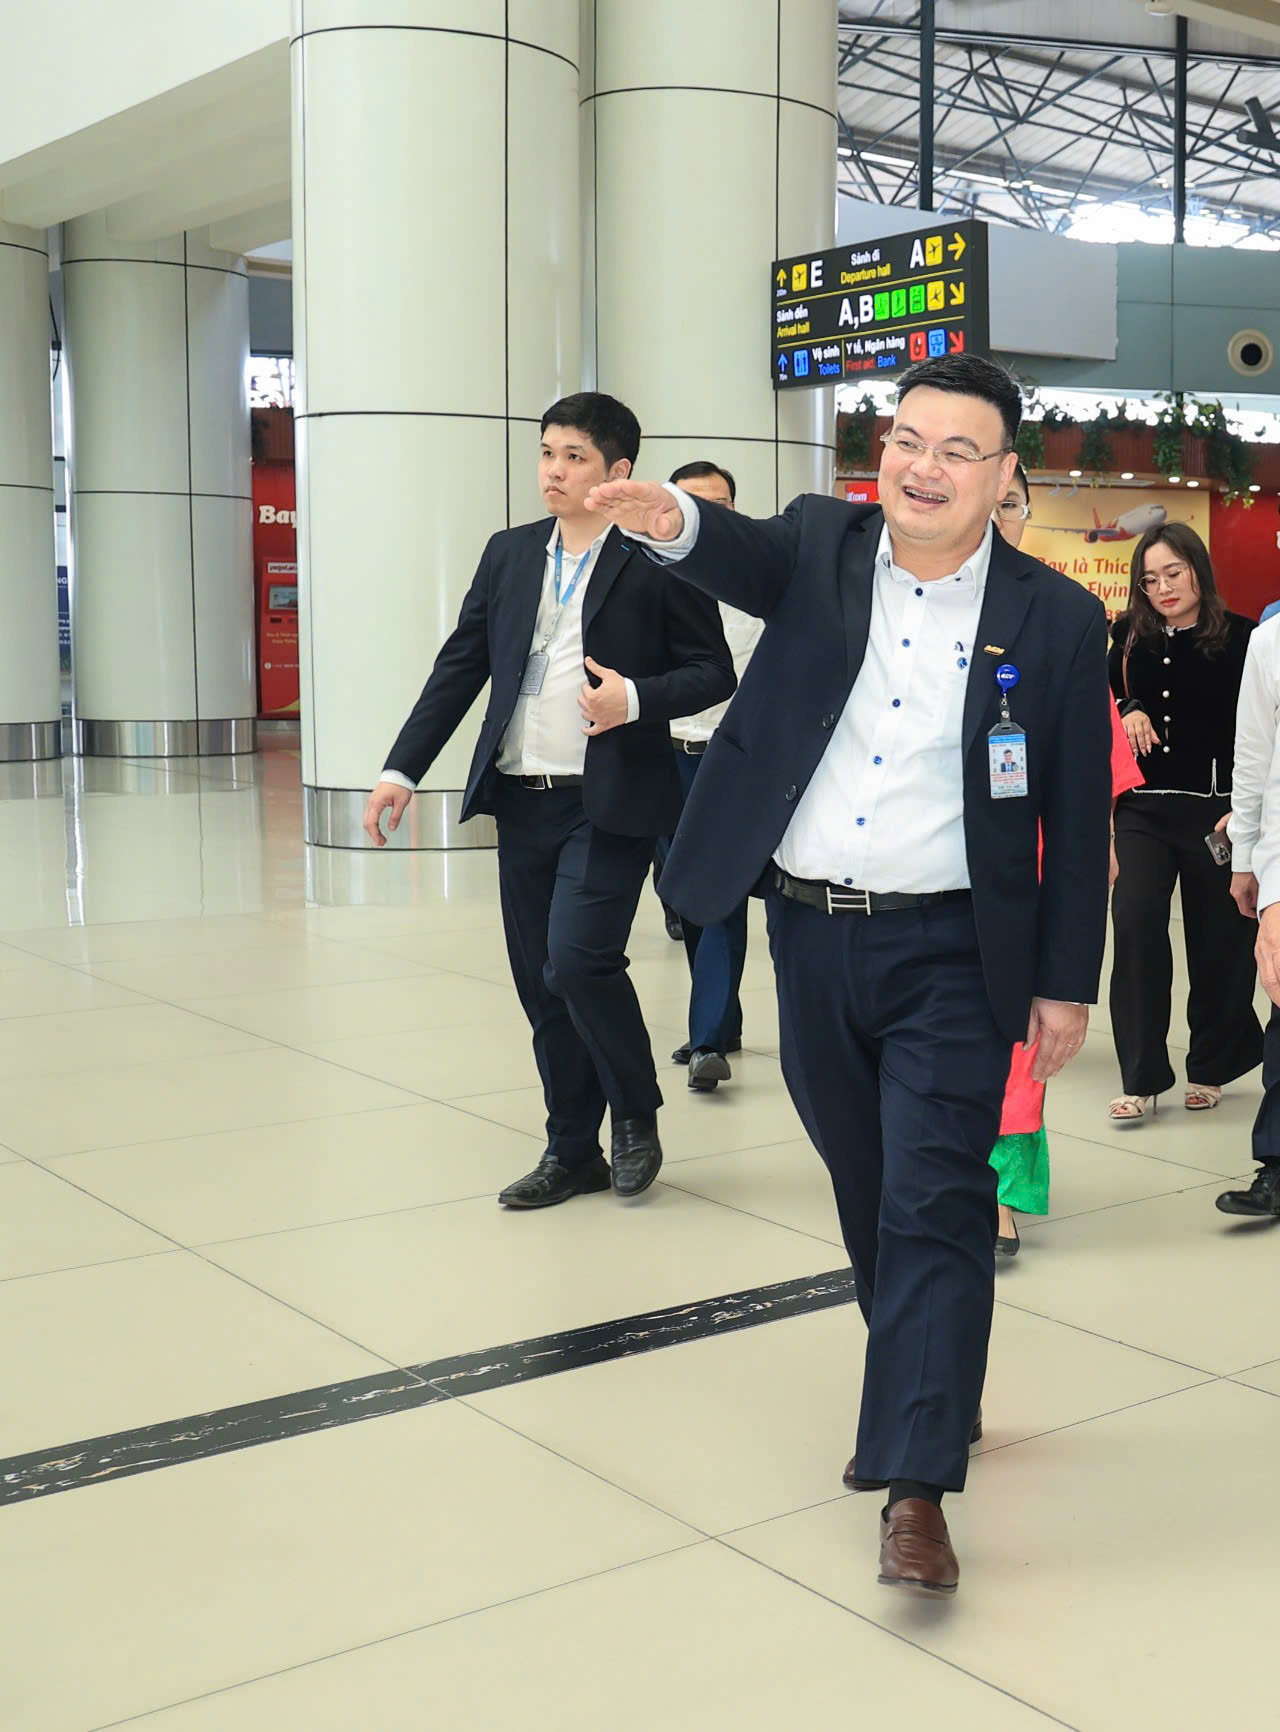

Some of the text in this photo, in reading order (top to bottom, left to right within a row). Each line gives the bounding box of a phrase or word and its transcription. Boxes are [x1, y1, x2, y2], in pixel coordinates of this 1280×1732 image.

[851, 248, 880, 266] Sảnh đi
[909, 238, 925, 269] A
[810, 259, 823, 288] E
[841, 263, 891, 284] Departure hall
[776, 308, 794, 323] Sảnh
[838, 294, 874, 330] A,B
[776, 320, 810, 338] Arrival hall
[812, 345, 840, 362] Vệ sinh
[845, 342, 852, 355] Y
[864, 338, 885, 355] Ngân
[886, 336, 905, 350] hàng
[818, 363, 841, 376] Toilets
[846, 359, 863, 372] First
[877, 353, 896, 368] Bank
[1073, 556, 1088, 574] là
